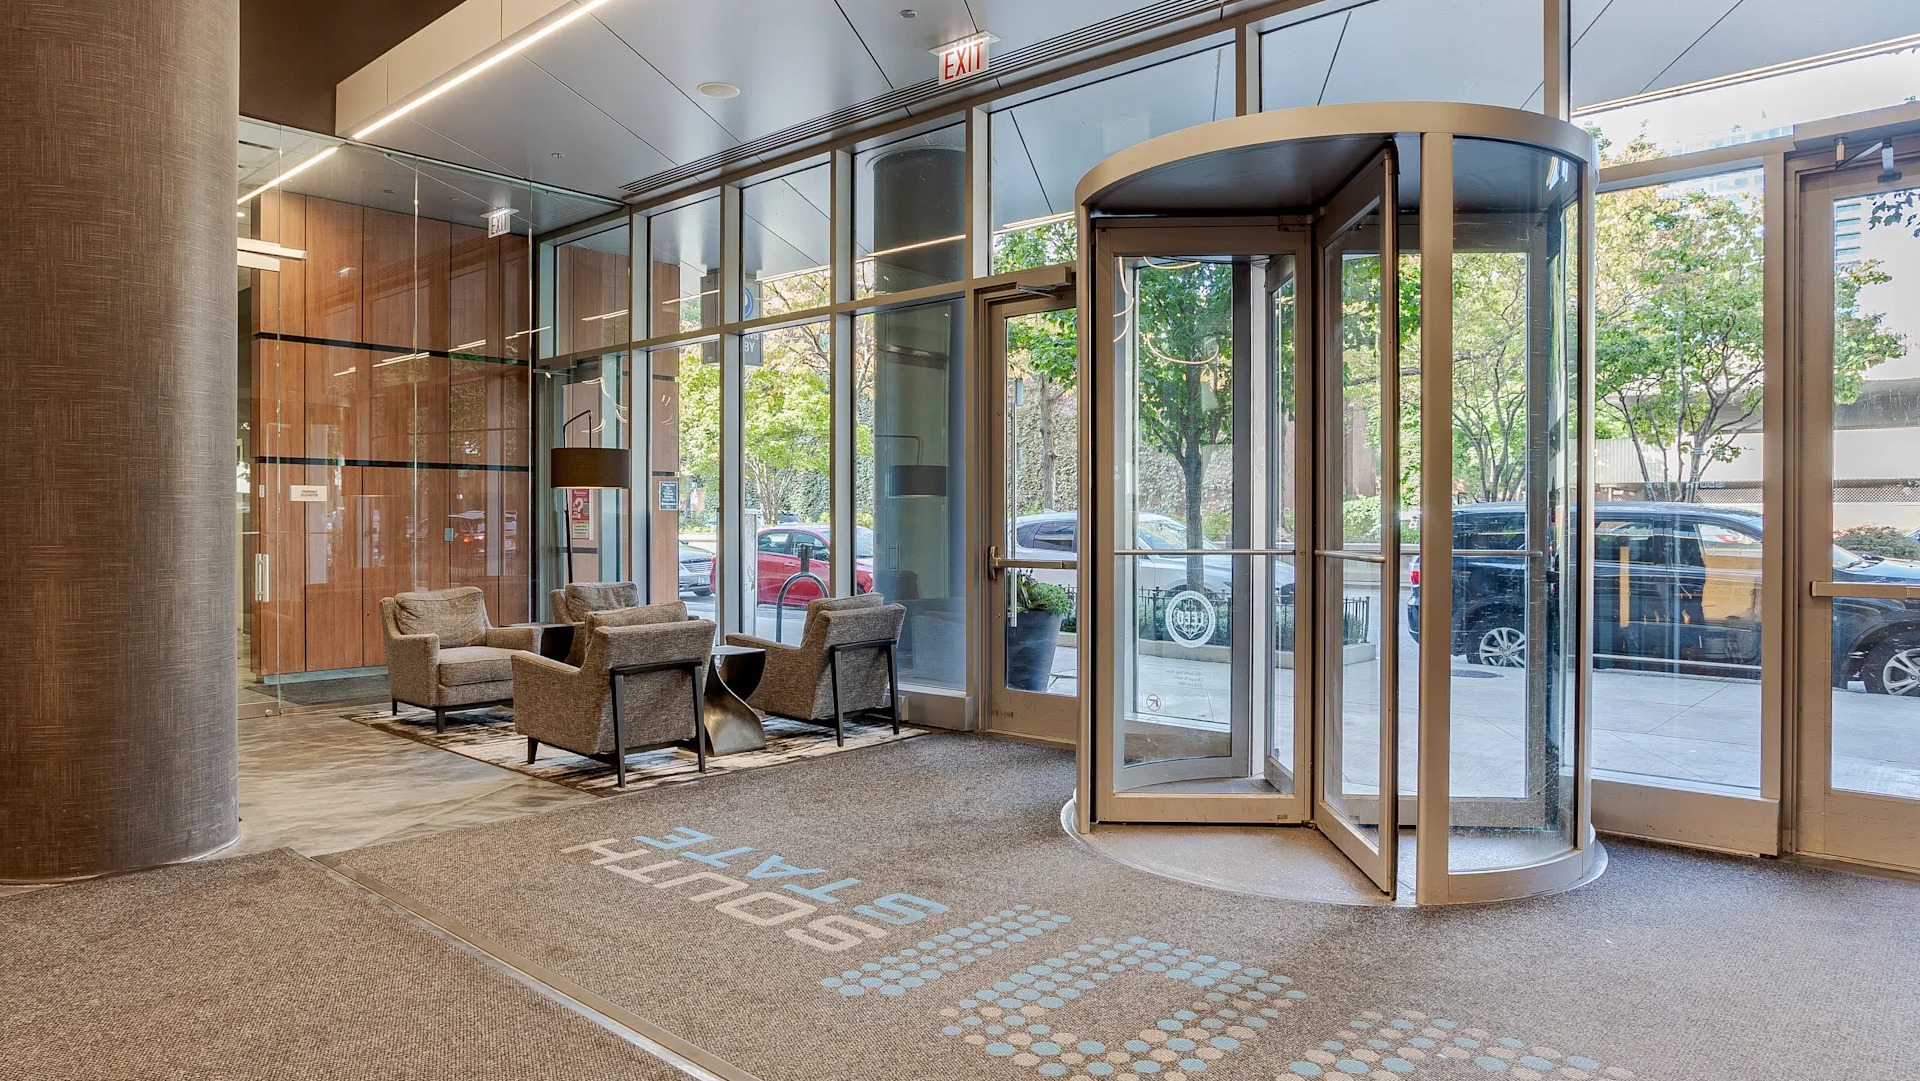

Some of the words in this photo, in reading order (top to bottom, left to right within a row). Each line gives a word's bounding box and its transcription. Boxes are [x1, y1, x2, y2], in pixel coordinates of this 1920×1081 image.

[944, 21, 984, 61] EXIT
[491, 213, 508, 235] EXIT
[560, 837, 888, 953] SOUTH
[633, 826, 951, 925] STATE
